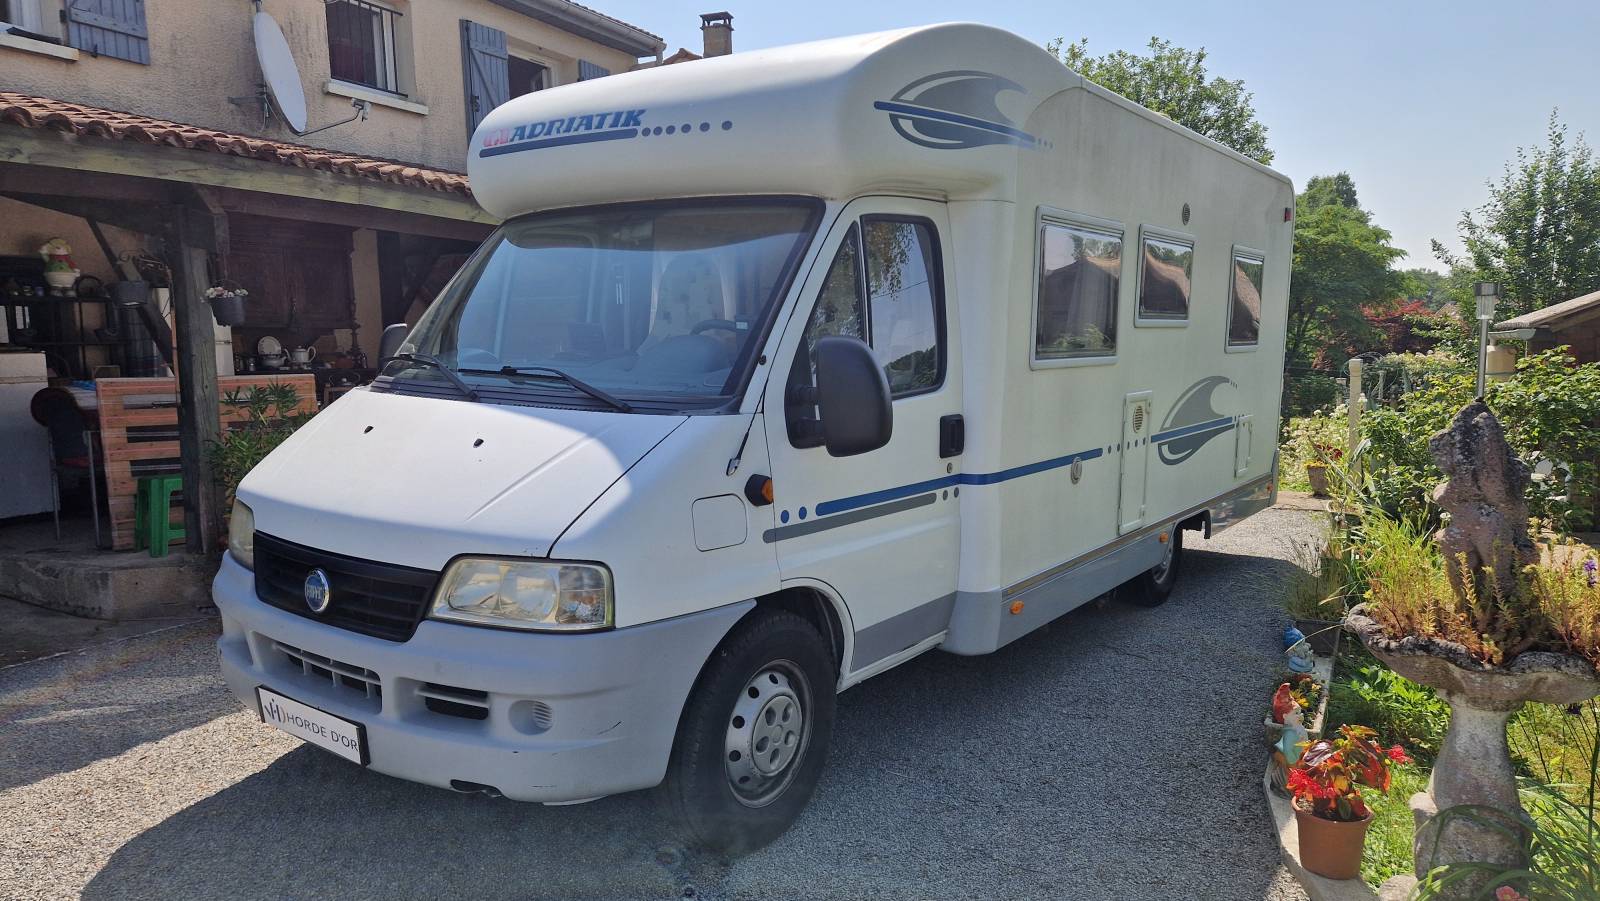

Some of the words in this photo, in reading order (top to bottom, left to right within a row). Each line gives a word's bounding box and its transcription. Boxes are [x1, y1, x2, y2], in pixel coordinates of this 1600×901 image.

[510, 109, 647, 142] ADRIATIK
[286, 712, 327, 738] HORDE
[330, 730, 359, 752] D'OR
